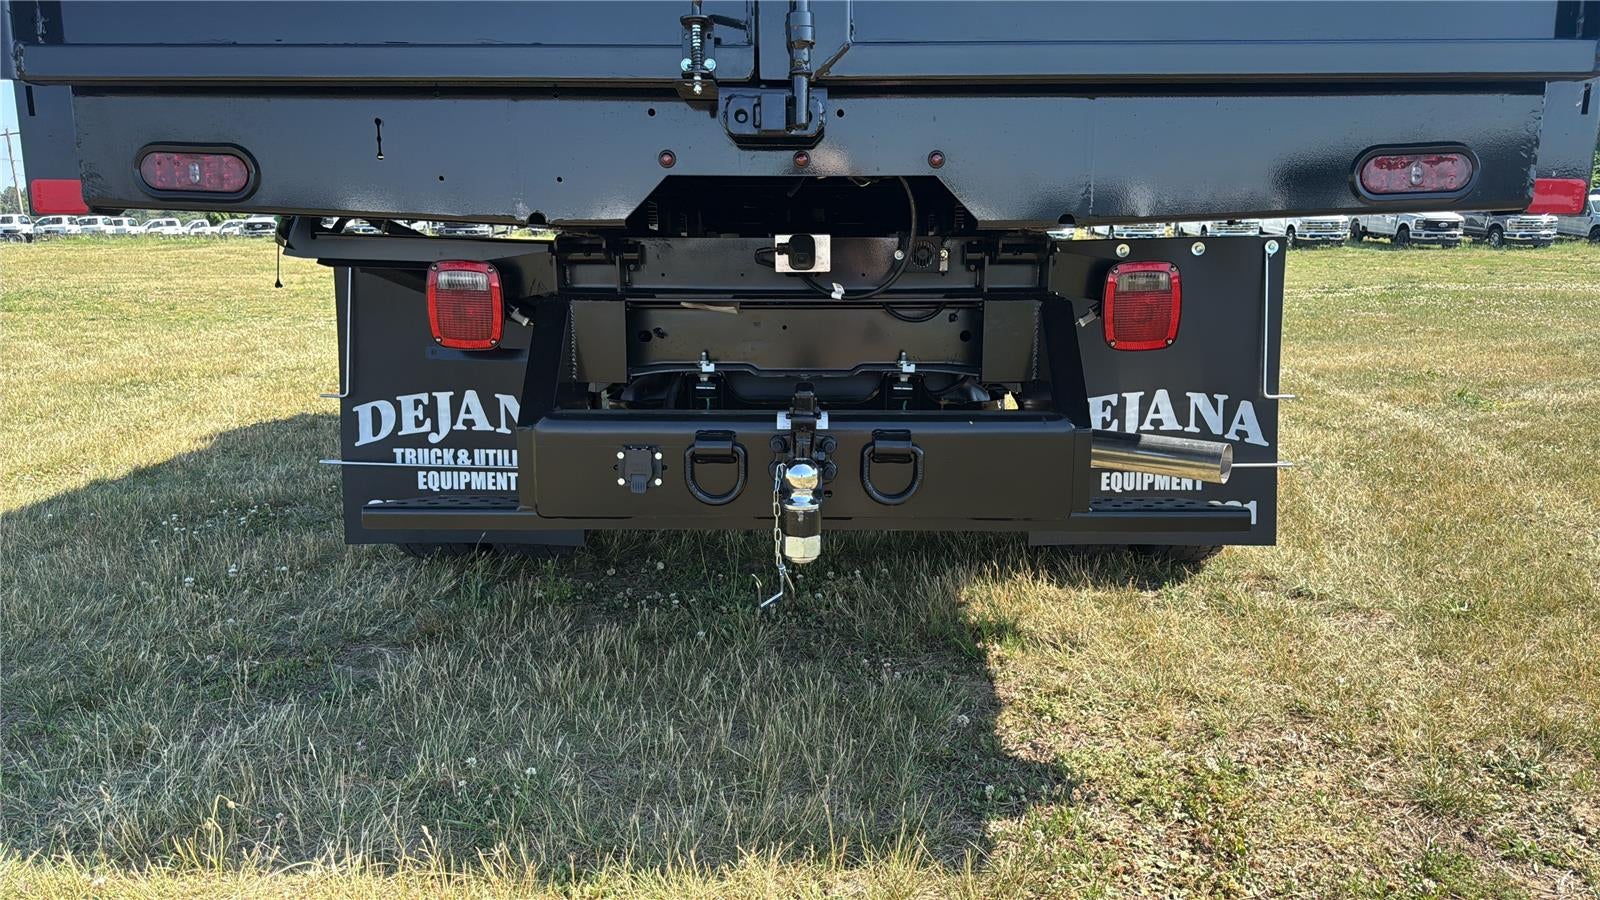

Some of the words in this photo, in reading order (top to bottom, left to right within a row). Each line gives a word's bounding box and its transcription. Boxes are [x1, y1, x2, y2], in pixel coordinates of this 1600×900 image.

[352, 389, 521, 447] DEJAN
[1087, 389, 1270, 447] EJANA
[417, 471, 519, 491] EQUIPMENT
